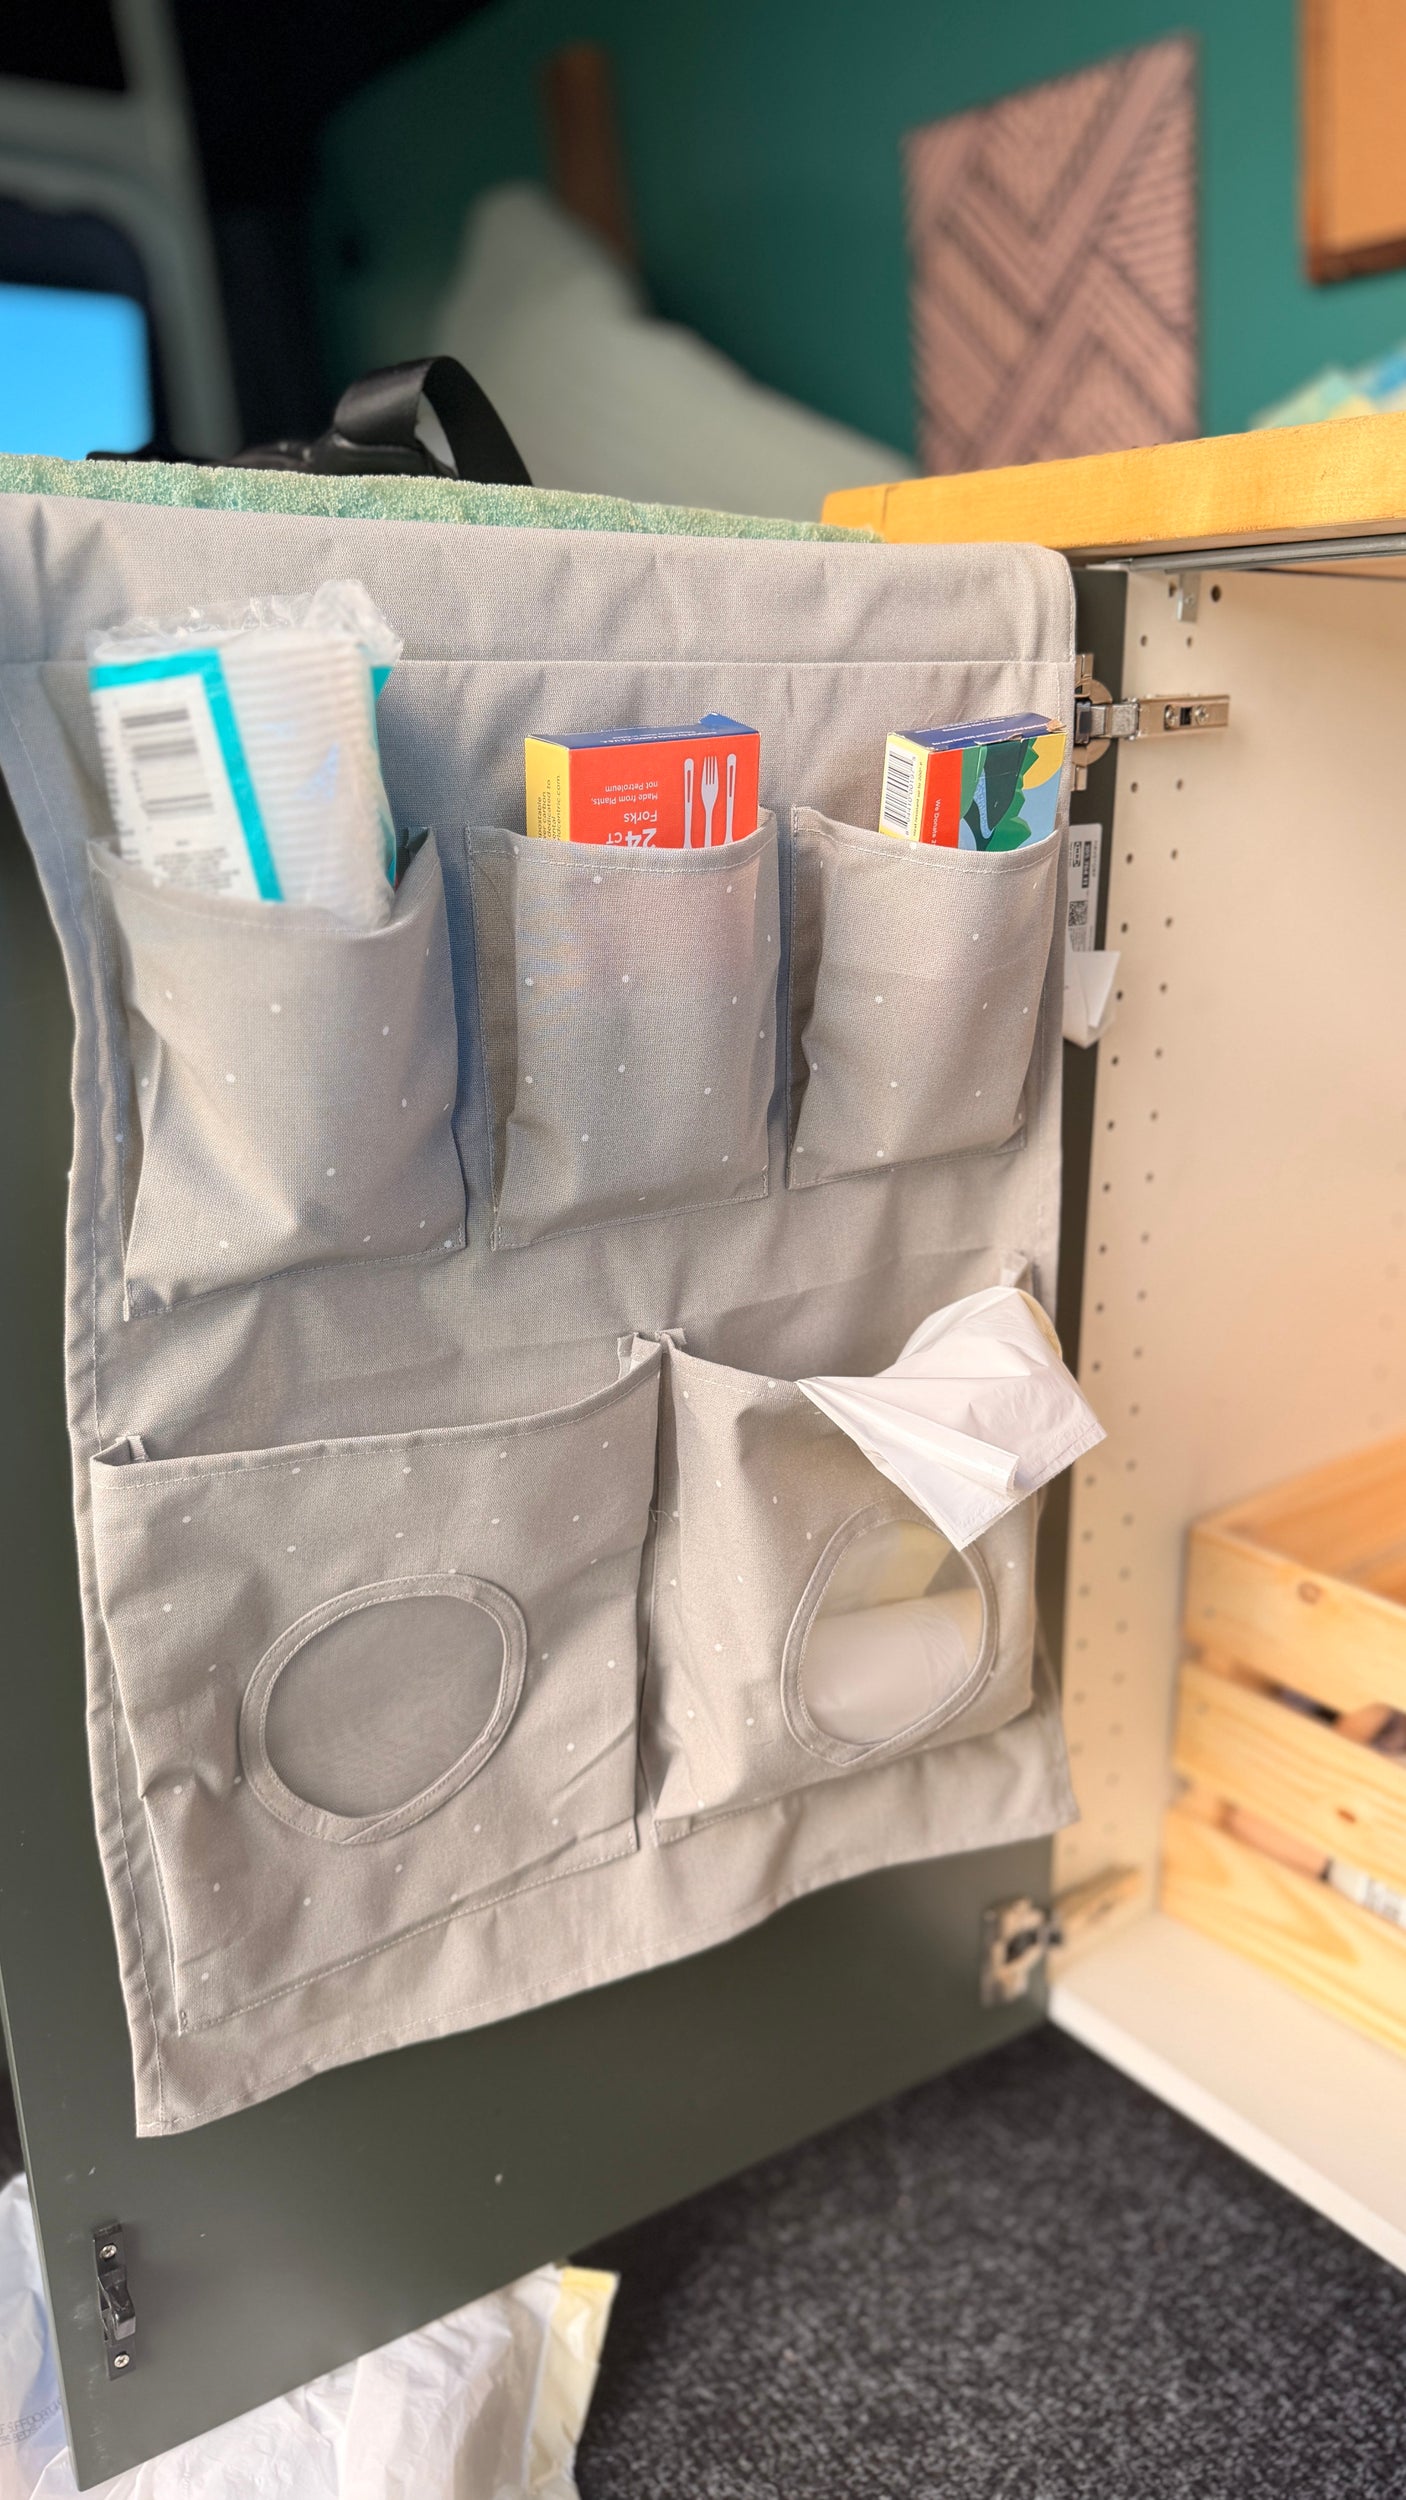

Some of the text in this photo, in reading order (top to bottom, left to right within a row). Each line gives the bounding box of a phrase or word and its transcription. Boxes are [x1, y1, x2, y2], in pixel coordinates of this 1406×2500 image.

[605, 781, 658, 792] not Petroleum
[591, 793, 658, 805] Made from Plants,
[934, 798, 942, 811] We
[623, 810, 658, 824] Forks
[931, 813, 941, 838] Donate
[606, 828, 657, 848] 24 CT
